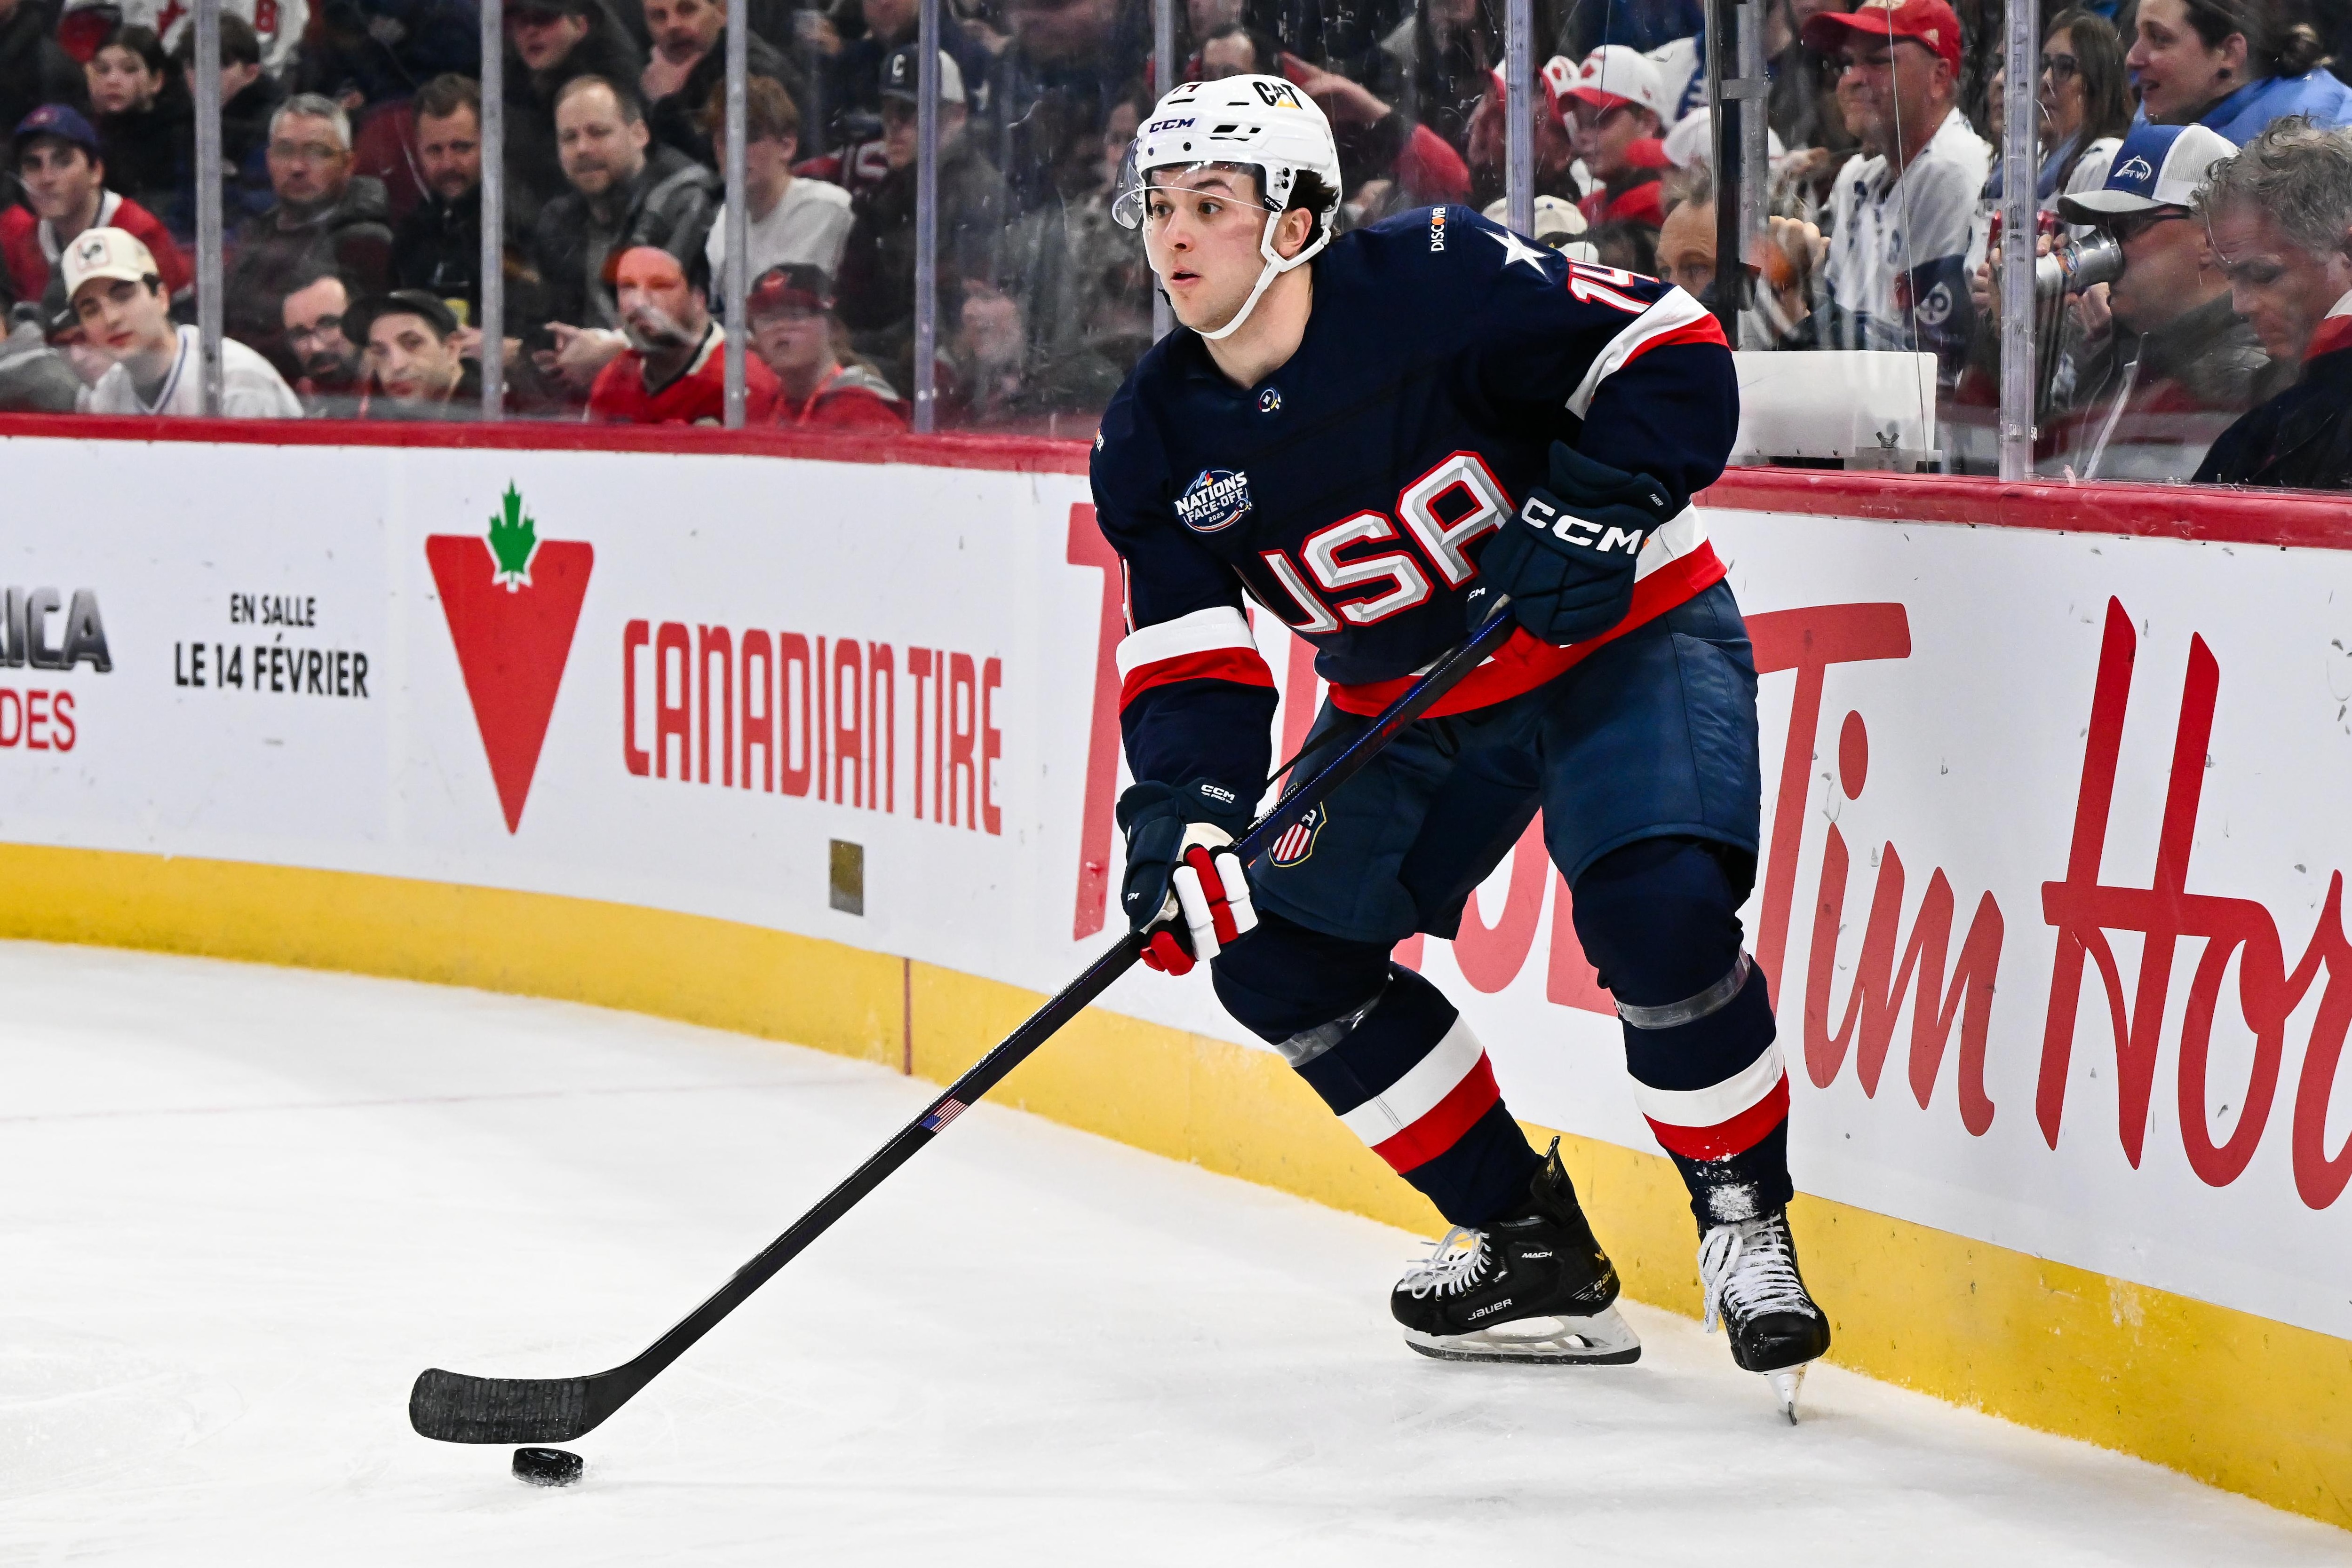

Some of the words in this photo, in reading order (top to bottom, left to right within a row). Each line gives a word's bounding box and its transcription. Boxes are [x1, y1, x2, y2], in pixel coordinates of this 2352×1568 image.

[1252, 81, 1303, 110] CAT
[1149, 118, 1195, 133] CCM
[1265, 198, 1280, 211] CCM
[1431, 207, 1446, 251] DISCOVER
[1566, 257, 1659, 314] 14
[1174, 471, 1248, 515] NATIONS
[1186, 488, 1243, 523] FACE-OFF
[1649, 494, 1664, 507] FABER
[1232, 450, 1518, 634] USA
[1521, 497, 1643, 554] CCM
[0, 585, 113, 673] ICA
[230, 593, 255, 624] EN
[262, 594, 317, 627] SALLE
[175, 641, 206, 687] LE
[216, 644, 244, 689] 14
[254, 633, 369, 698] FÉVRIER
[623, 618, 895, 814] CANADIAN
[907, 647, 1002, 836] TIRE
[1201, 784, 1235, 800] CCM
[1743, 602, 2004, 1137] Tim
